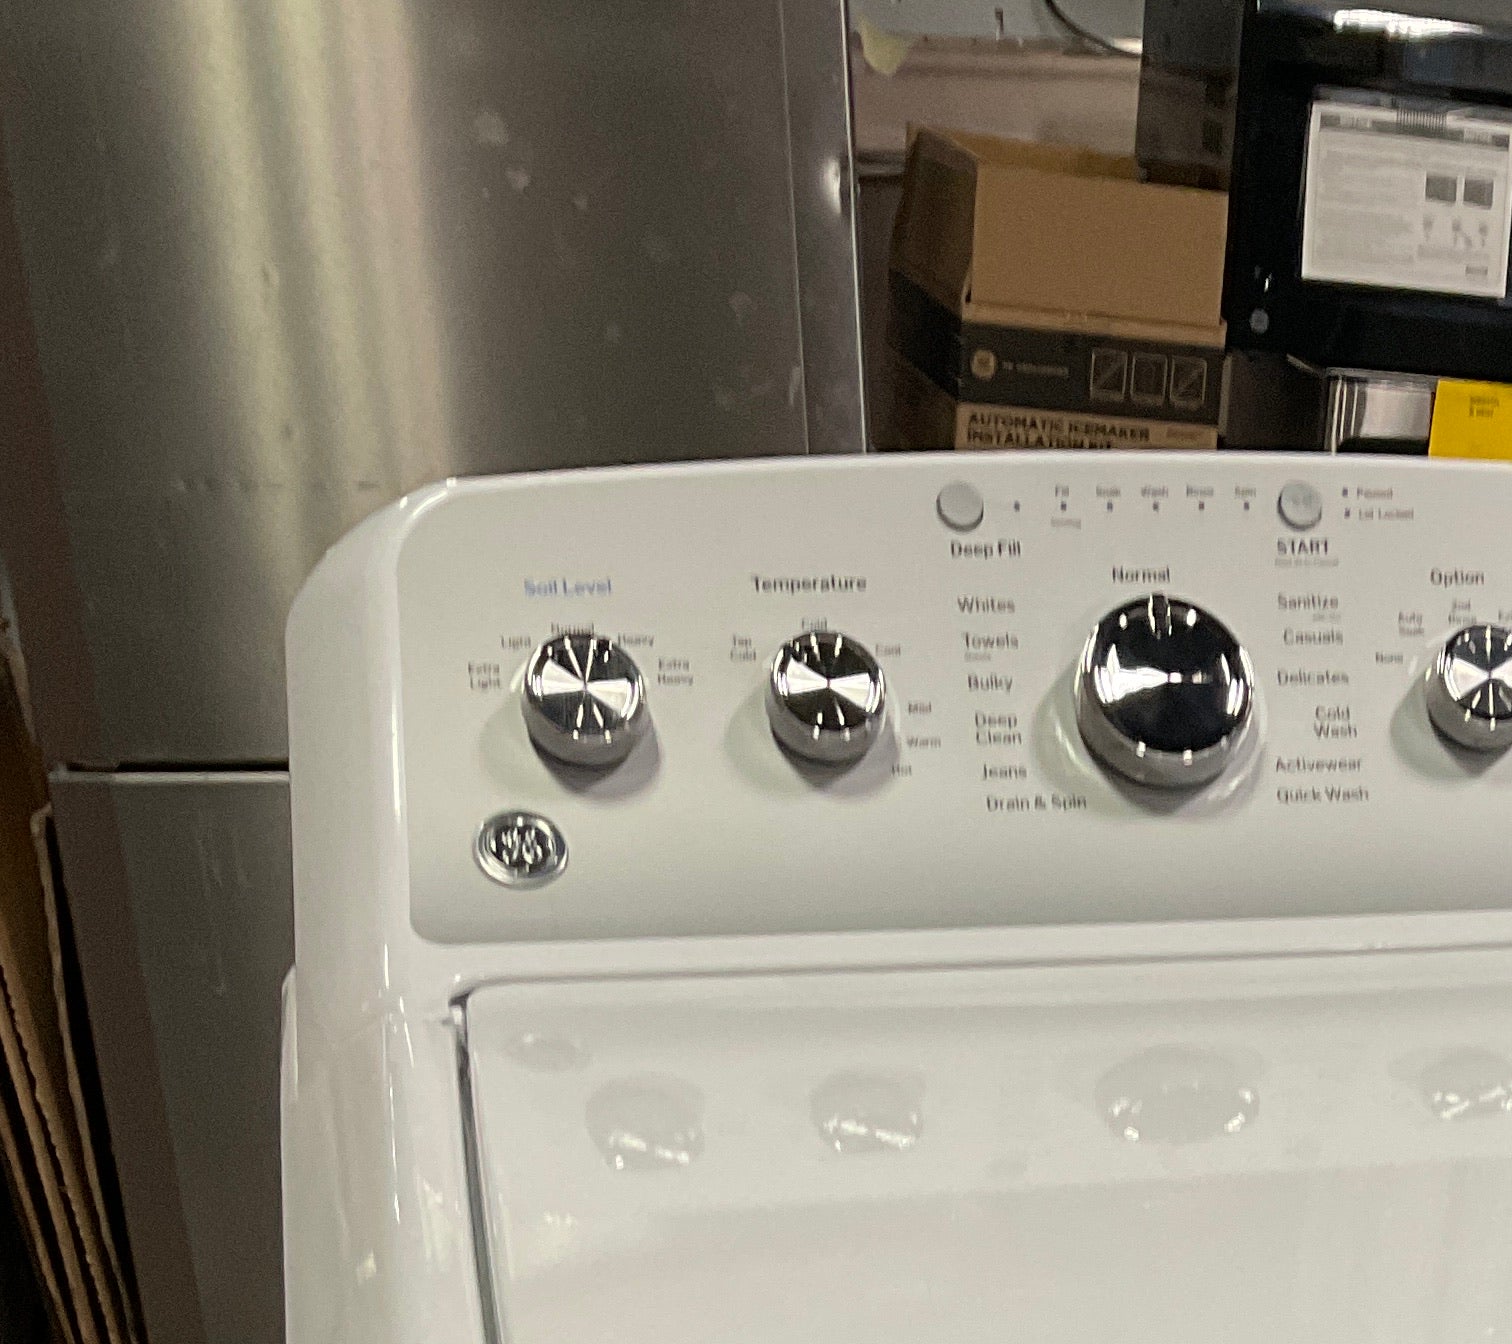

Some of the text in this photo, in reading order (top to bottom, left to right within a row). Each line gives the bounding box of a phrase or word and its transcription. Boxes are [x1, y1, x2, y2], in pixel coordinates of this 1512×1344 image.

[950, 538, 1021, 560] Deep Fill
[1276, 537, 1329, 556] START
[1112, 565, 1171, 583] Normal
[1430, 567, 1485, 588] Option
[524, 577, 612, 596] Soil Level
[752, 574, 867, 594] Temperature
[957, 596, 1016, 614] Whites
[1278, 592, 1339, 610] Sanitize
[963, 631, 1018, 649] Towels
[1283, 626, 1343, 645] Casuals
[967, 673, 1013, 693] Bulky
[1277, 670, 1349, 686] Delicates
[975, 713, 1018, 729] Deep
[1315, 705, 1350, 721] Cold
[976, 729, 1022, 744] Clean
[1313, 722, 1358, 739] Wash
[983, 763, 1027, 780] Jeans
[1276, 757, 1361, 773] Activewear
[986, 795, 1088, 812] Drain & Spin
[1276, 786, 1369, 804] Quick Wash
